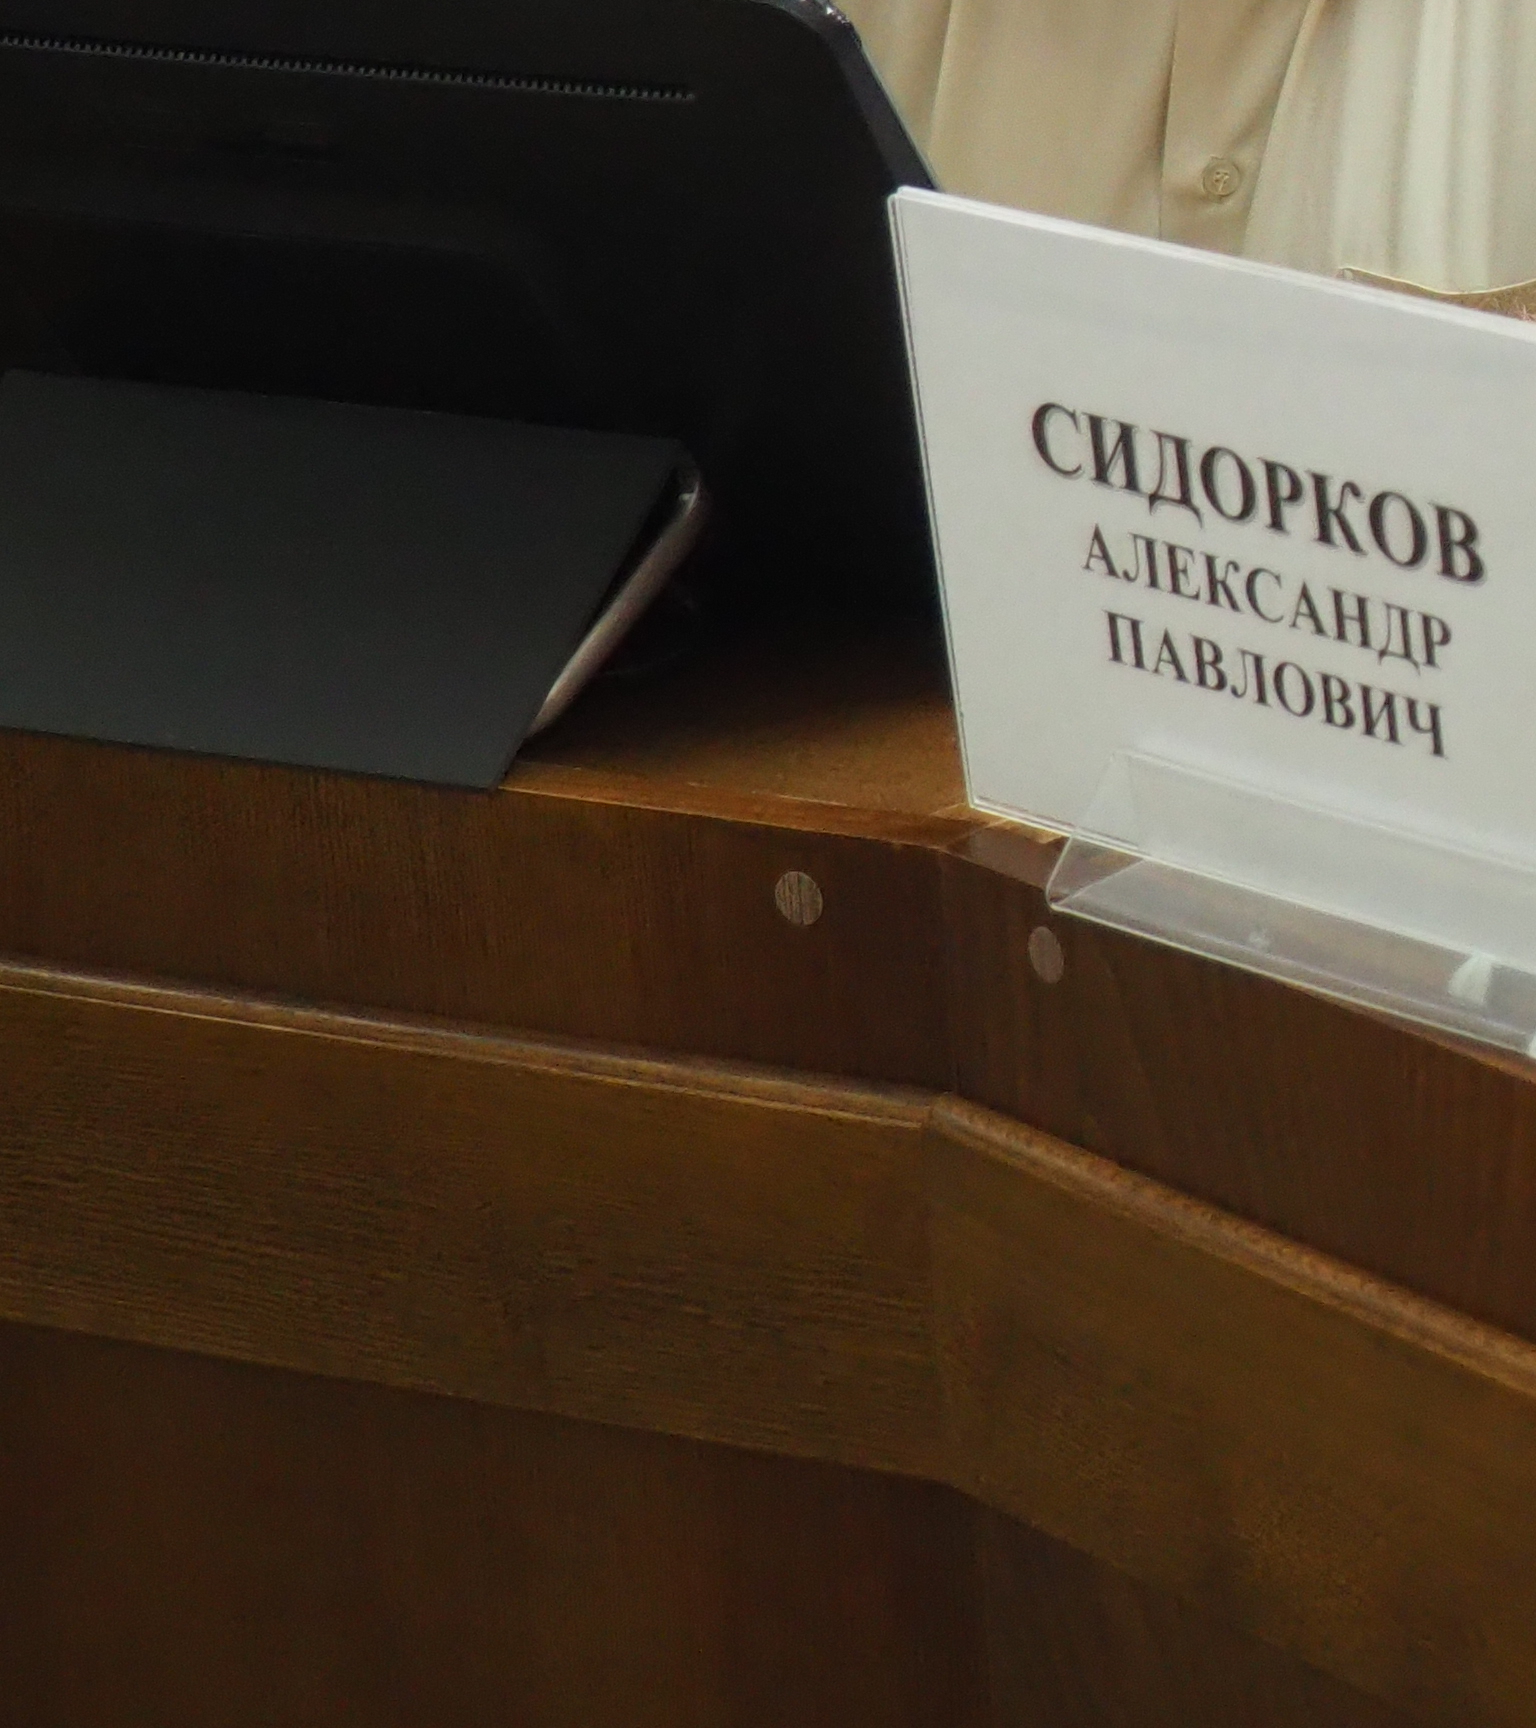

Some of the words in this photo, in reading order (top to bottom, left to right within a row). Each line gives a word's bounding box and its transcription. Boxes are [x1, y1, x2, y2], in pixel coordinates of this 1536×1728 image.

[1031, 402, 1486, 584] СИДОРКОВ
[1082, 524, 1453, 671] АЛЕКСАНДР
[1104, 610, 1445, 758] ПАВЛОВИЧ
